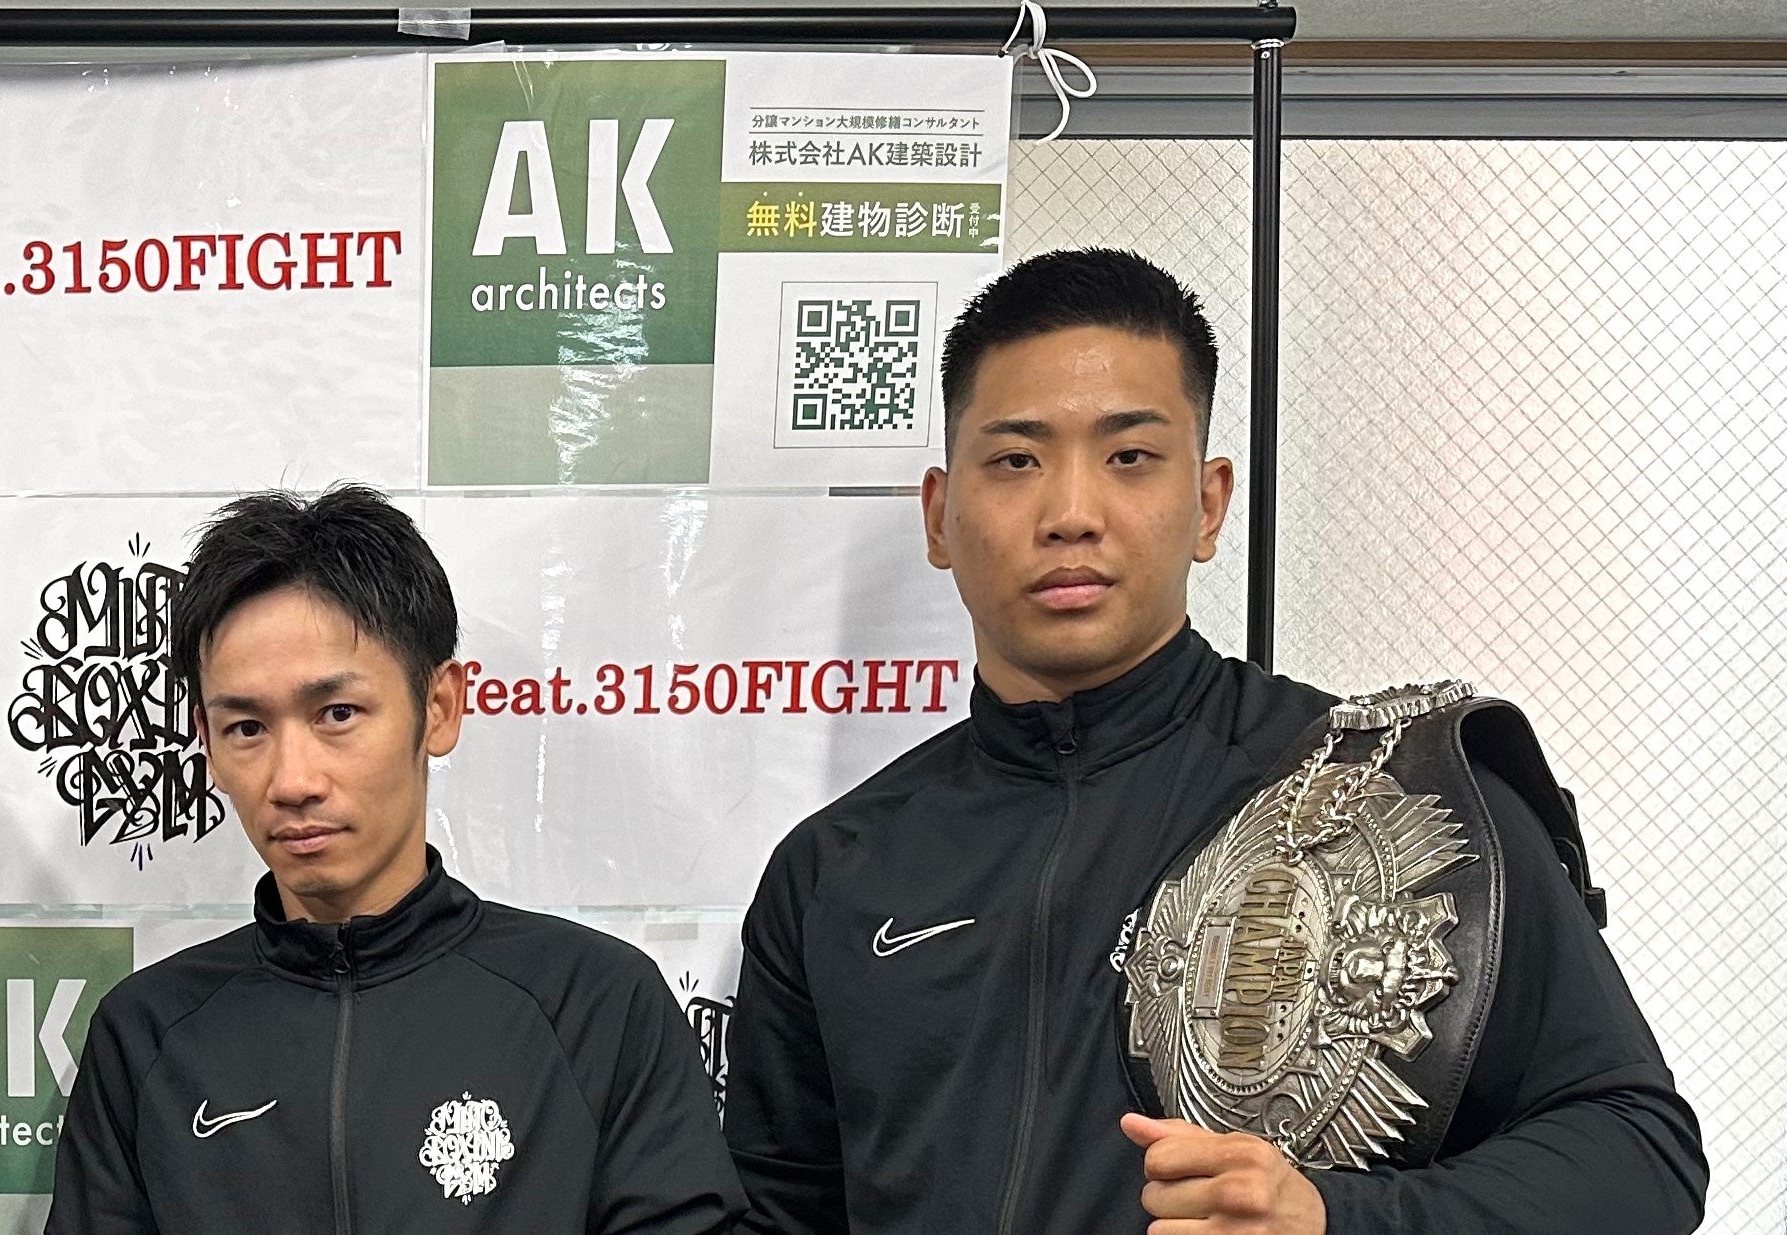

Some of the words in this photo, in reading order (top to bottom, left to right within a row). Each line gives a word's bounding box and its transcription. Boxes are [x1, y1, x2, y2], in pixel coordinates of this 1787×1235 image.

[749, 140, 983, 168] 株式会社AK建築設計
[472, 118, 675, 257] AK
[471, 267, 667, 312] architects
[462, 659, 959, 715] feat.3150FIGHT
[1217, 869, 1299, 1071] CHAMPION
